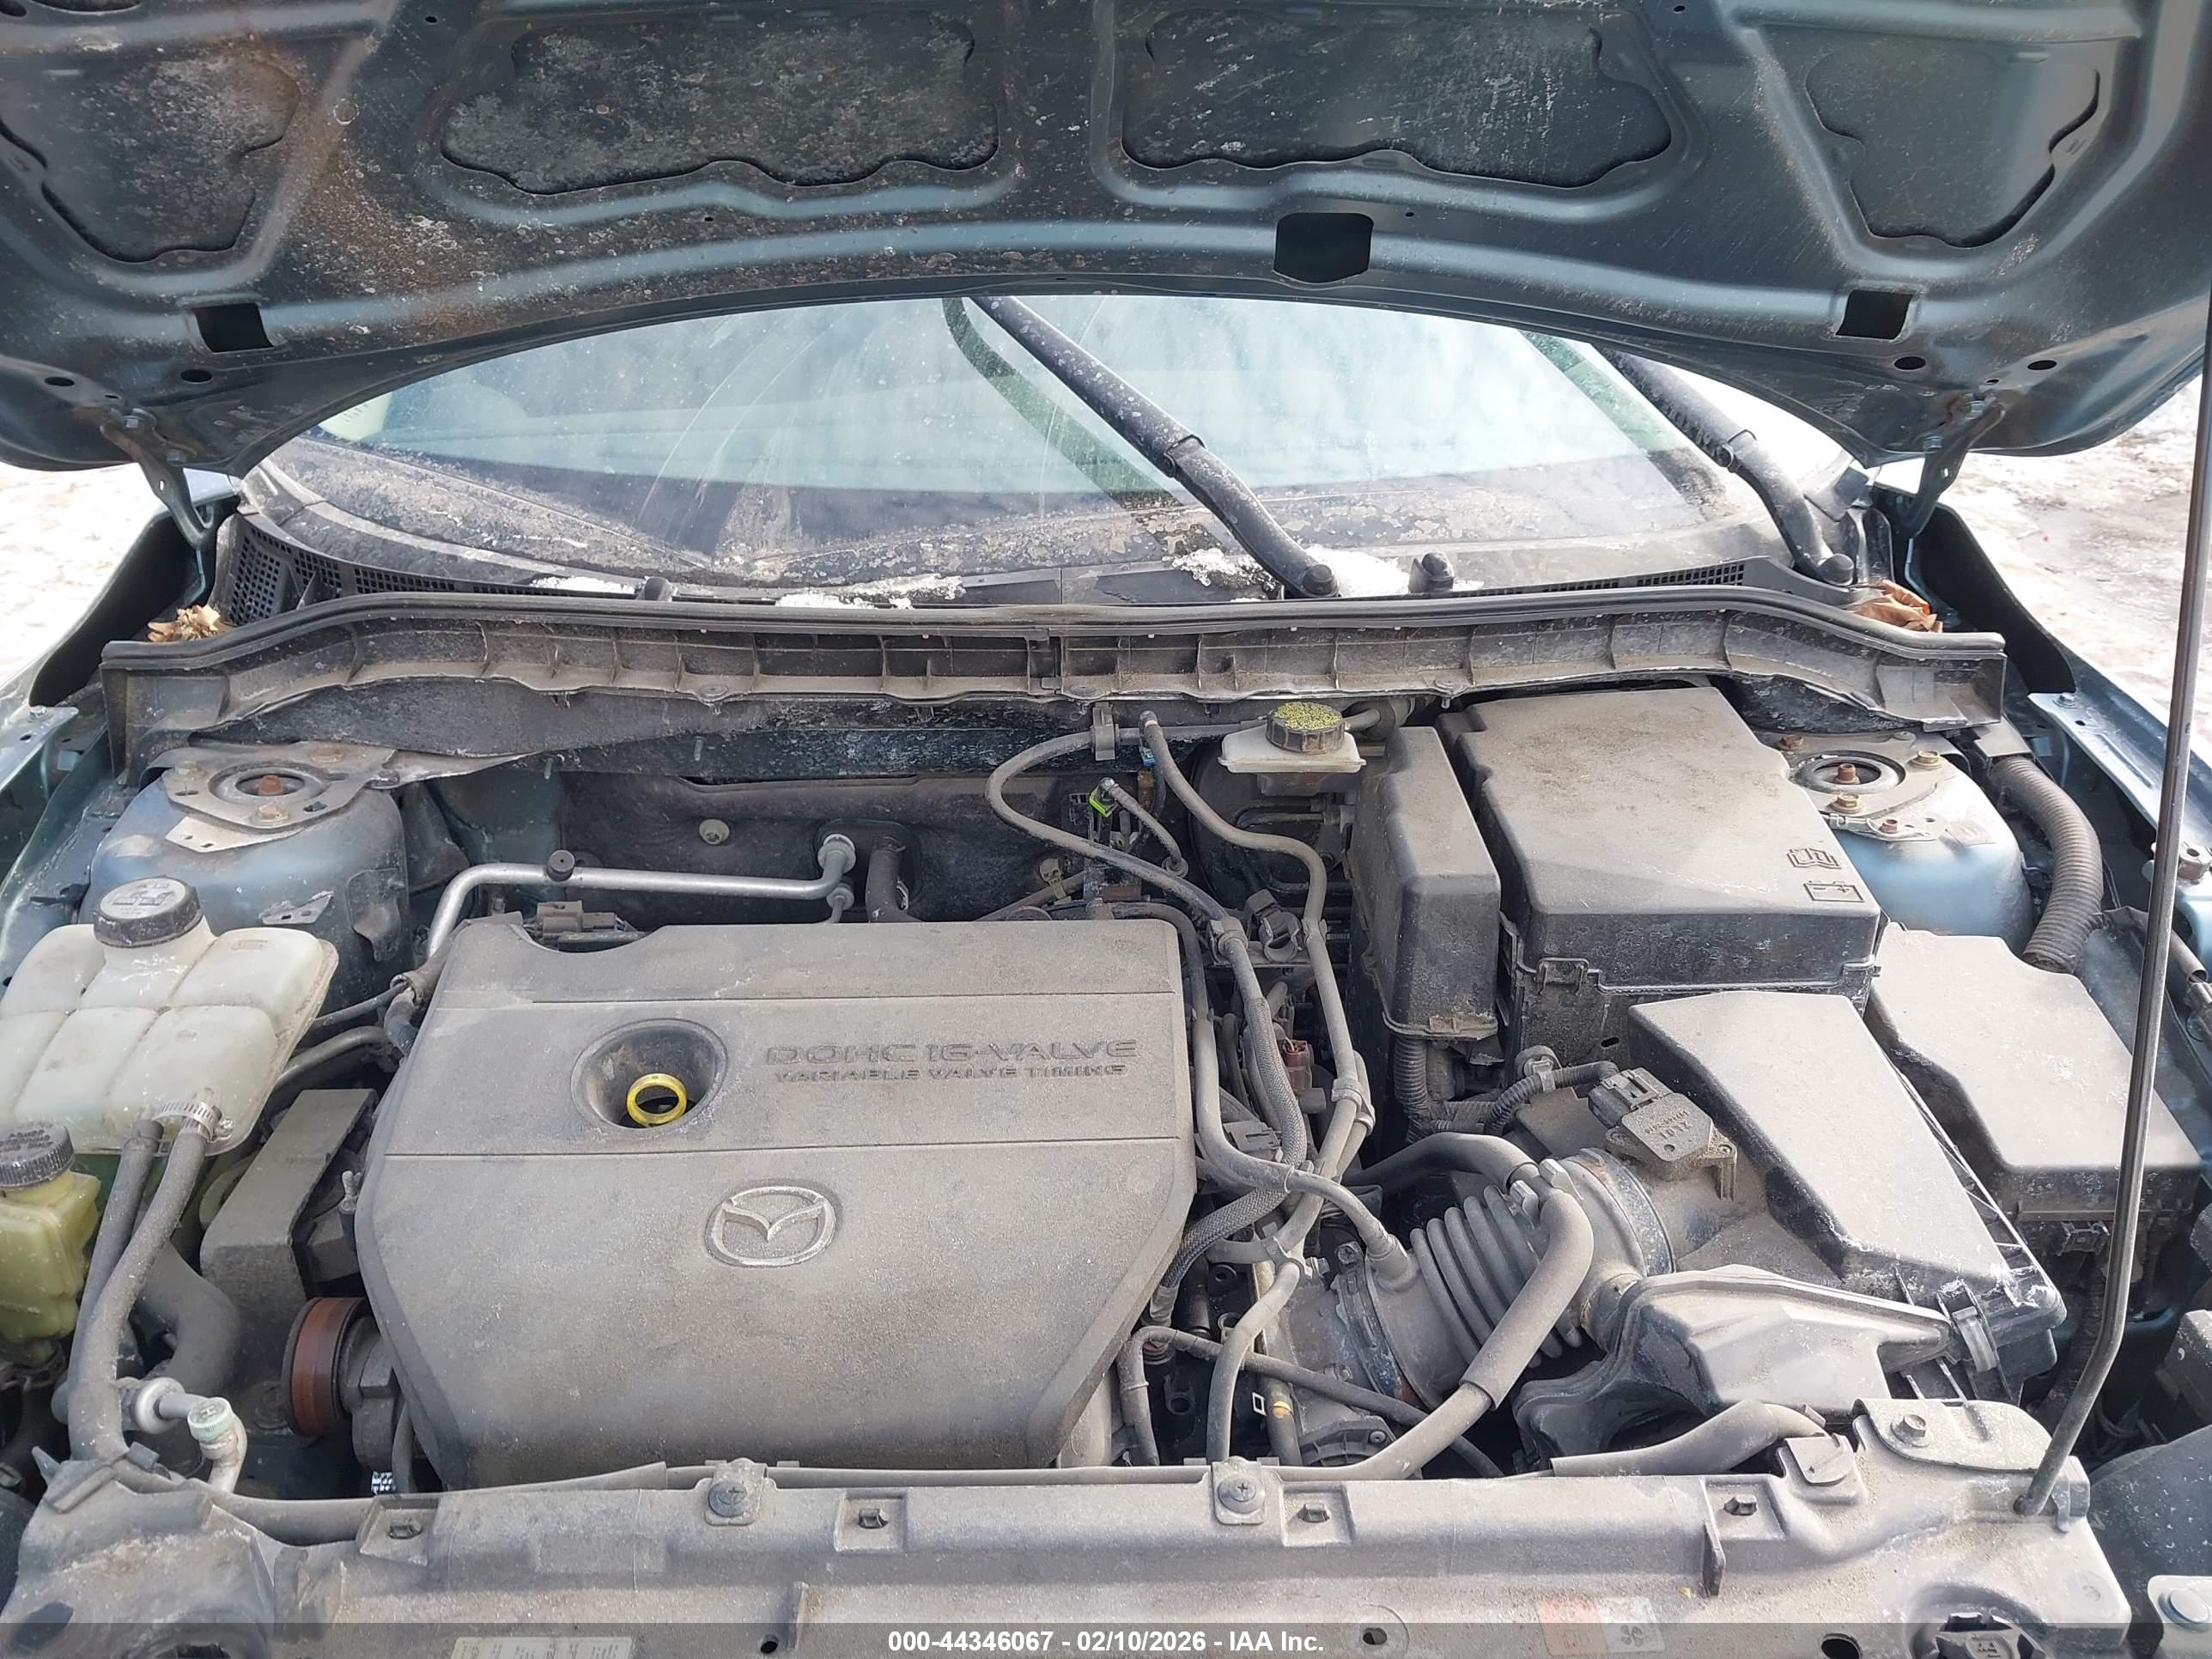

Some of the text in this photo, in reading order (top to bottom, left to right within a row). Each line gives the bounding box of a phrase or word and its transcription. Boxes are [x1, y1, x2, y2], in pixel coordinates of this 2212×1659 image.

[767, 1040, 1138, 1065] DOHC 16-VALVE
[775, 1068, 920, 1083] VARIABLE
[927, 1066, 1018, 1080] VALVE
